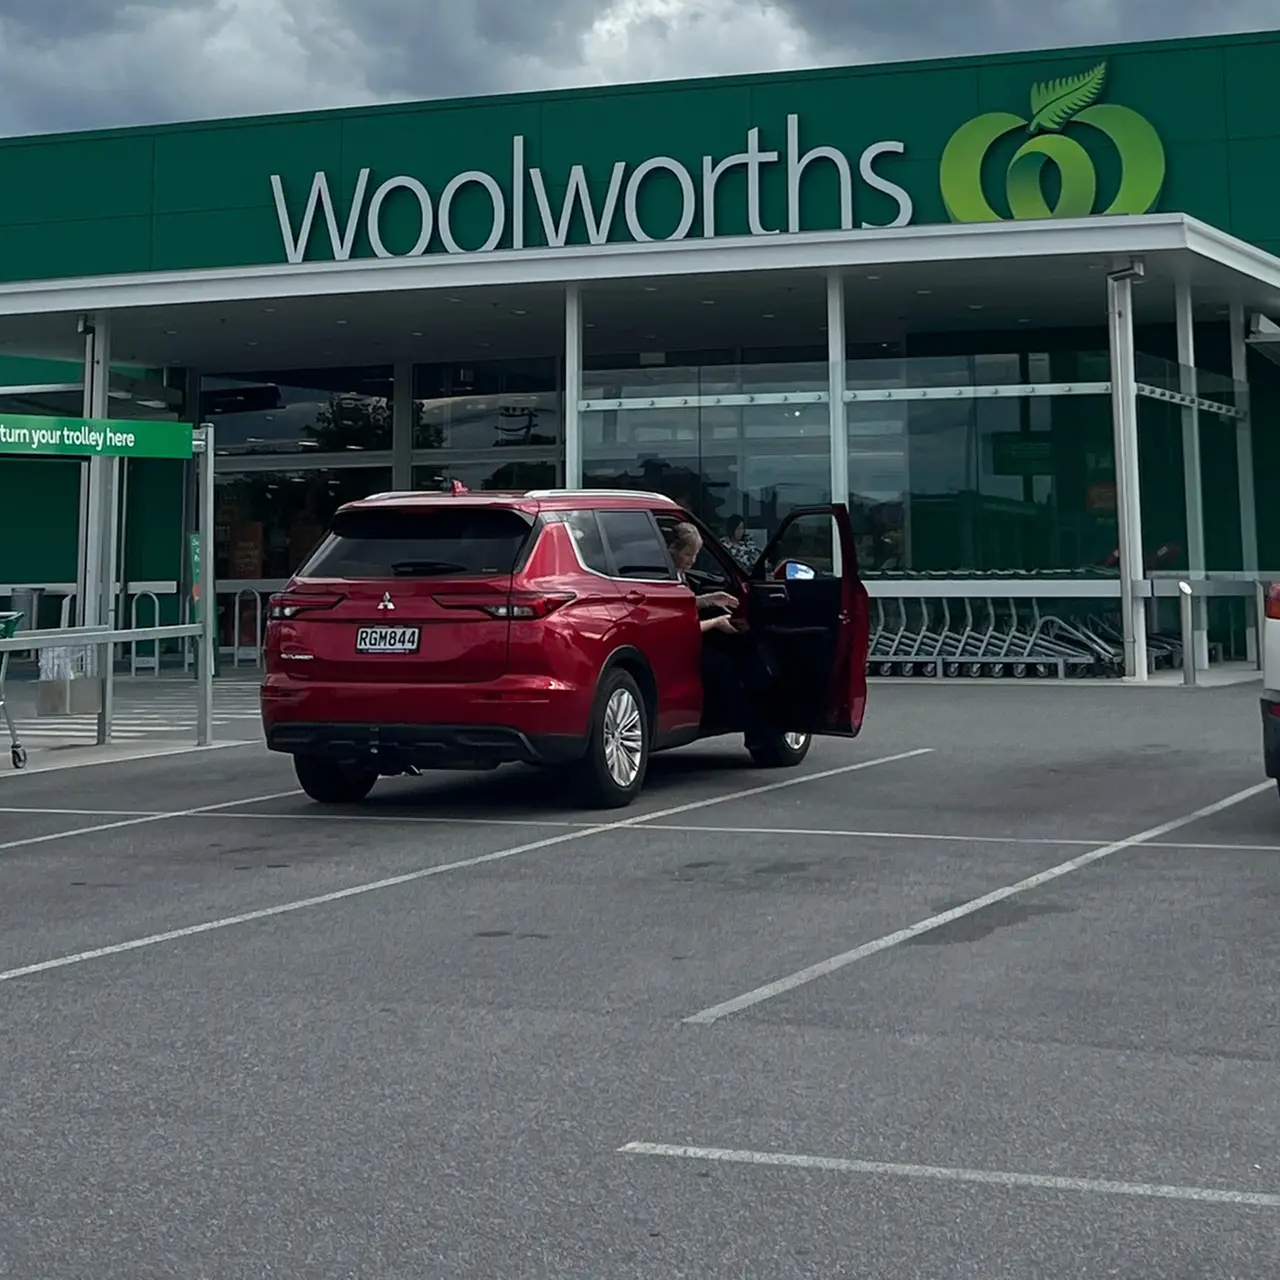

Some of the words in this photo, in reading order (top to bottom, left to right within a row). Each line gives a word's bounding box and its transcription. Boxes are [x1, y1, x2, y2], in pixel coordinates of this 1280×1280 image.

[270, 114, 915, 264] Woolworths
[31, 429, 61, 448] your
[63, 426, 104, 451] trolley
[106, 428, 135, 447] here
[358, 630, 417, 647] RGM844
